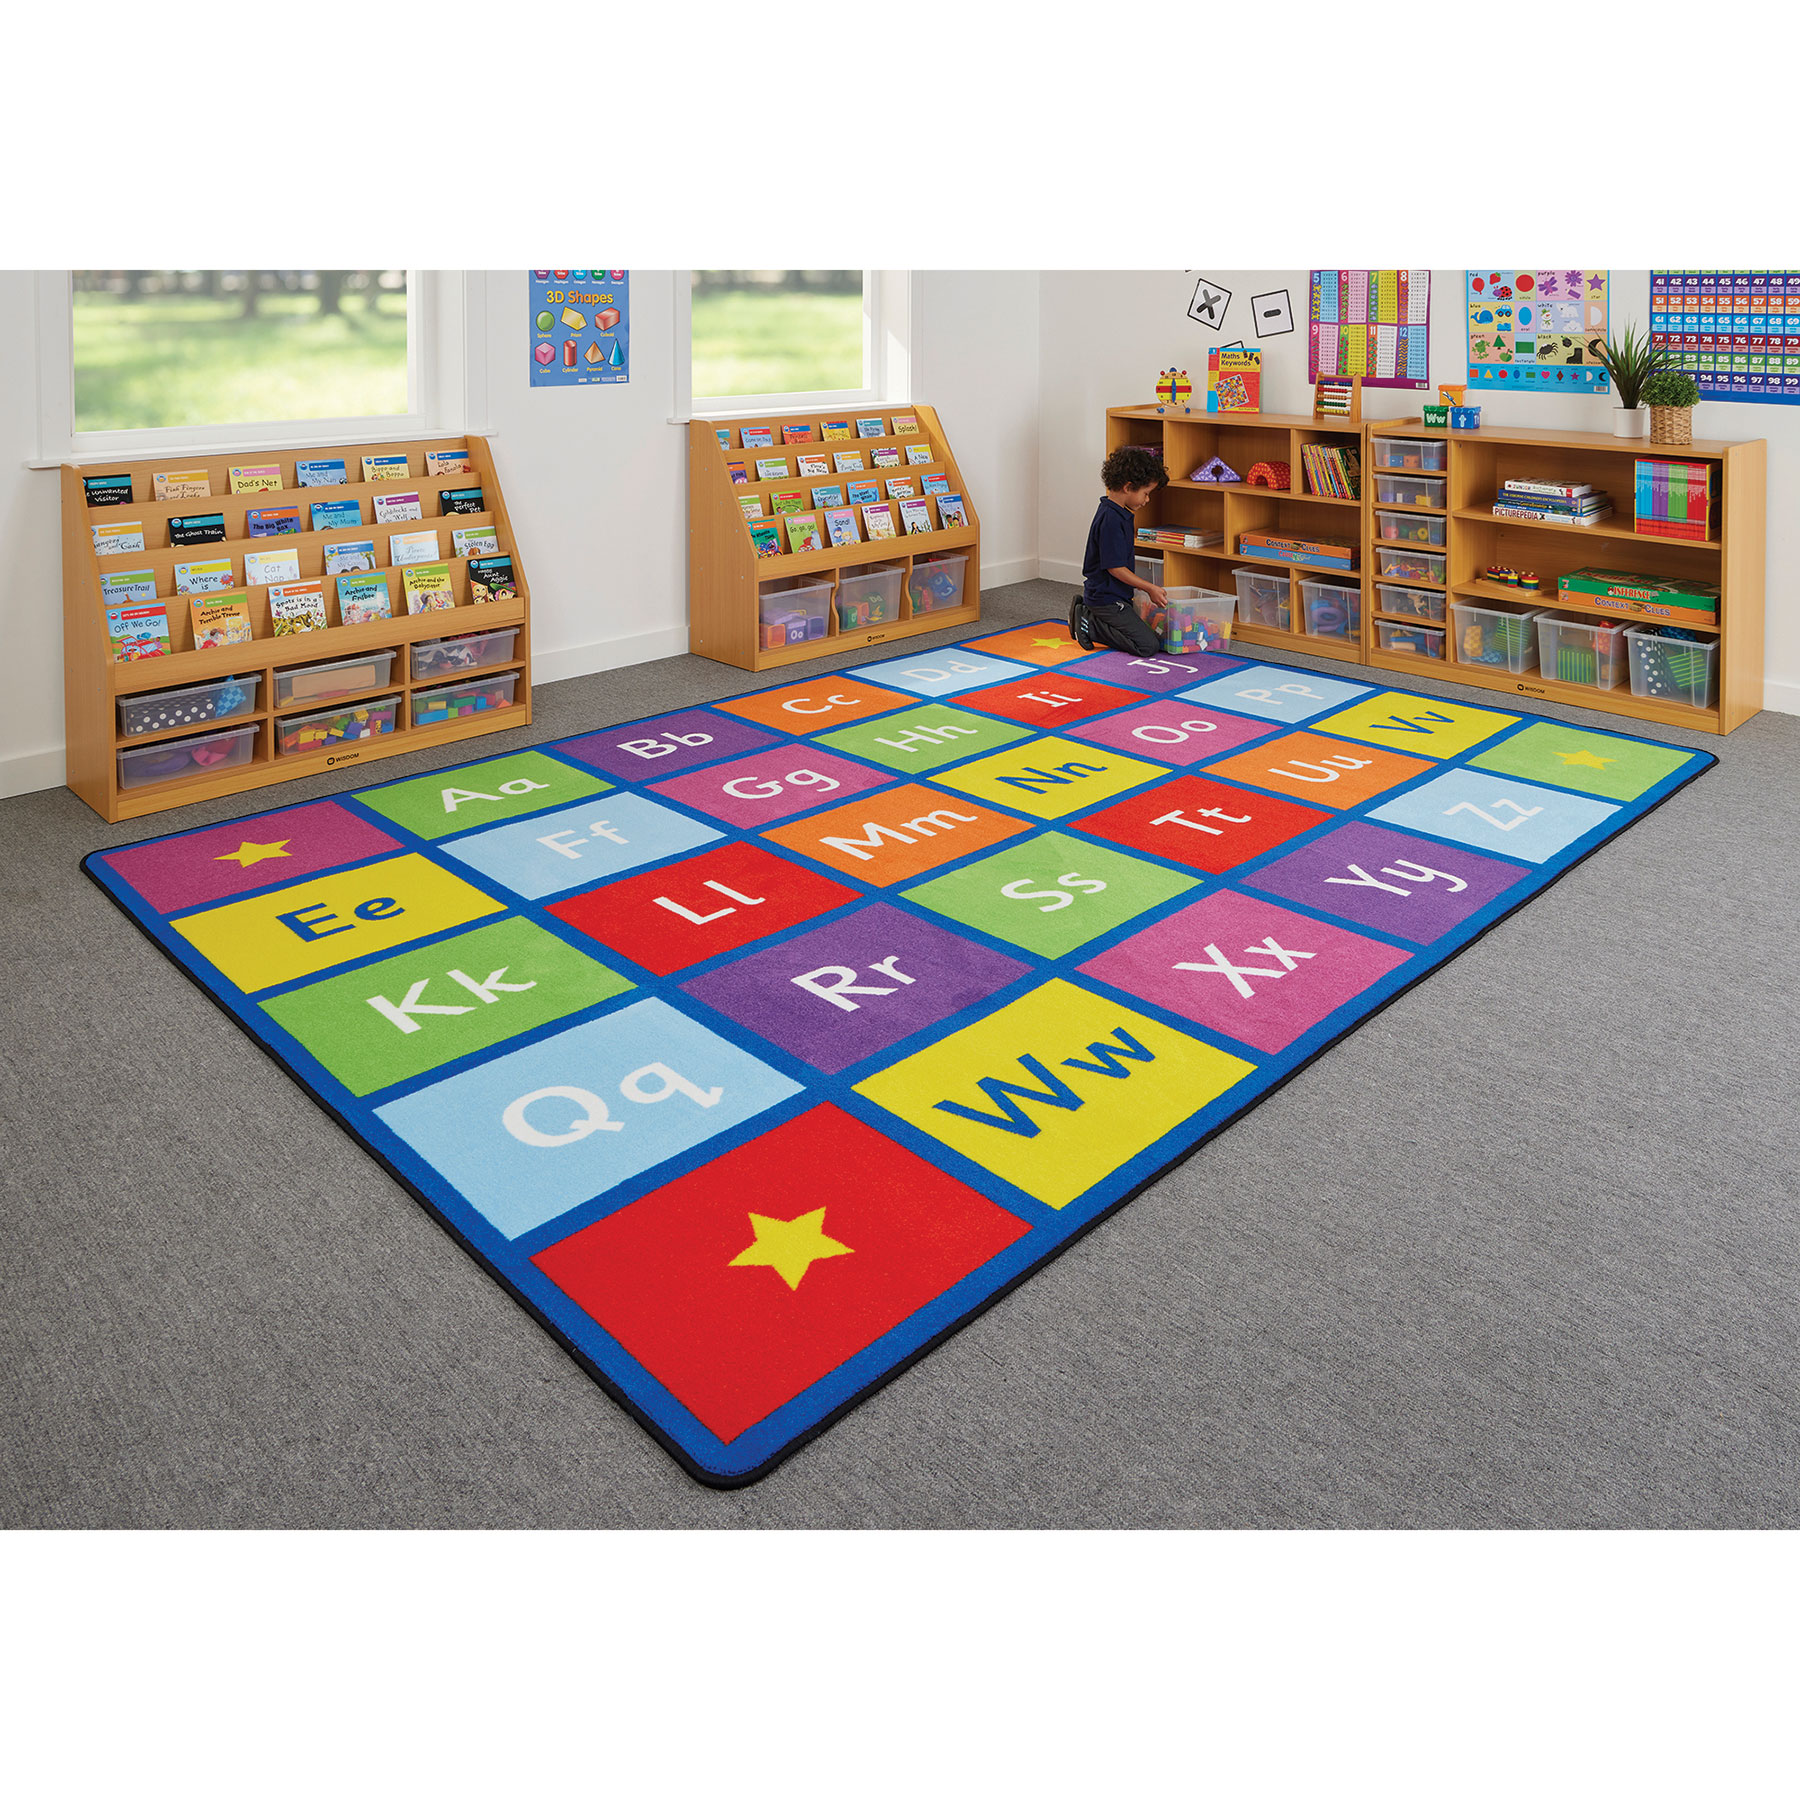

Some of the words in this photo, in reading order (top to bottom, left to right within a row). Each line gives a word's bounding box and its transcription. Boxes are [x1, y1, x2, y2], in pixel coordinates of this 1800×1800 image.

[1313, 273, 1320, 282] 5
[1341, 272, 1347, 281] 6
[1371, 272, 1377, 282] 7
[1400, 271, 1407, 281] 8
[546, 290, 565, 303] 3D
[568, 290, 614, 307] Shapes
[1312, 325, 1318, 335] 9
[1370, 326, 1376, 335] 11
[1400, 327, 1407, 337] 12
[238, 480, 259, 489] Dad's
[265, 522, 275, 530] Big
[275, 517, 294, 526] White
[1494, 508, 1538, 520] PICTUREPEDIA
[464, 539, 483, 550] Stolen
[484, 540, 495, 549] Egg
[1266, 539, 1291, 549] CONTEXT
[1301, 543, 1320, 553] CLUES
[264, 564, 281, 574] Cat
[103, 585, 134, 595] Treasure
[134, 584, 150, 592] Trail
[189, 575, 218, 585] Where
[344, 588, 365, 596] Archie
[1614, 586, 1650, 600] INFERENCE
[200, 609, 220, 617] Archie
[276, 598, 295, 608] Spots
[285, 604, 299, 612] Bad
[1594, 597, 1629, 610] CONTEXT
[1644, 604, 1671, 616] CLUES
[114, 622, 130, 633] Off
[131, 620, 144, 628] We
[145, 619, 161, 627] Go!
[199, 614, 221, 625] Terrible
[791, 630, 804, 641] Oo
[899, 659, 989, 683] Dd
[1125, 657, 1200, 675] Jj
[781, 694, 861, 714] Cc
[1015, 690, 1084, 708] Ii
[1234, 684, 1324, 705] Pp
[1131, 720, 1218, 744] Oo
[1369, 711, 1455, 735] Vv
[616, 732, 714, 760] Bb
[873, 725, 978, 753] Hh
[336, 752, 359, 762] WISDOM
[995, 762, 1108, 795] Nn
[1267, 754, 1373, 783] Uu
[722, 768, 841, 800] Gg
[441, 778, 550, 814] Aa
[1149, 807, 1252, 836] Tt
[1442, 798, 1545, 832] Zz
[535, 820, 629, 860] Ff
[818, 809, 978, 861] Mm
[1323, 858, 1468, 897] Yy
[652, 879, 766, 926] Ll
[1000, 872, 1107, 913] Ss
[276, 897, 405, 943] Ee
[1171, 936, 1317, 1000] Xx
[790, 955, 917, 1013] Rr
[365, 966, 537, 1034] Kk
[933, 1026, 1156, 1139] Ww
[502, 1061, 724, 1148] Qq
